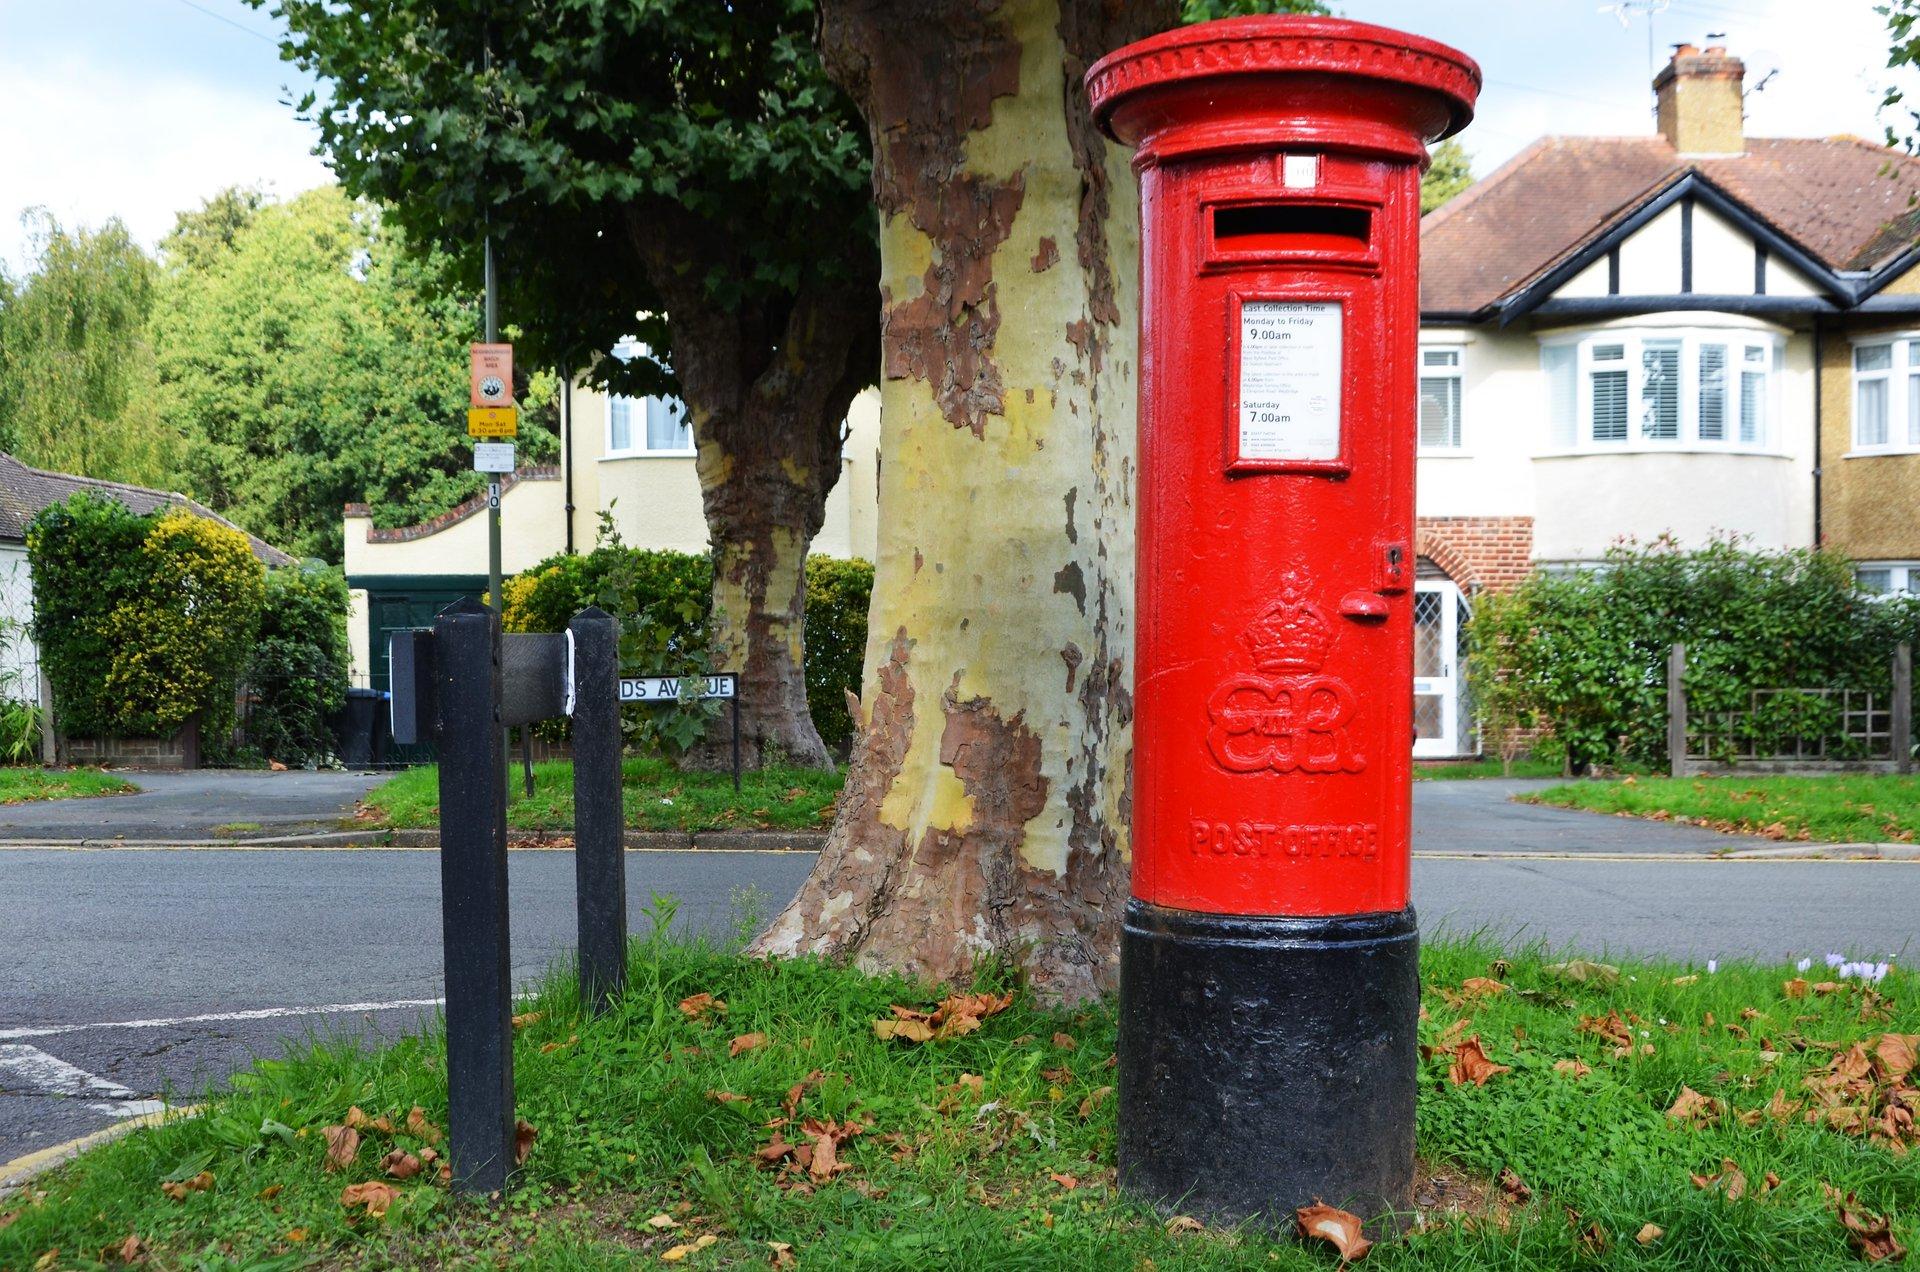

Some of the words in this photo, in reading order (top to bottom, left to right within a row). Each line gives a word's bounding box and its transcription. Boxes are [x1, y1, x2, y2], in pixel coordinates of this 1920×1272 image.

[1243, 304, 1261, 312] Last
[1263, 304, 1303, 312] Collection
[1305, 304, 1326, 312] Time
[1243, 317, 1275, 326] Monday
[1288, 317, 1314, 326] Friday
[1250, 328, 1291, 340] 9.00am
[1243, 401, 1280, 410] Saturday
[1250, 411, 1291, 423] 7.00am
[657, 677, 731, 697] AVUE
[1189, 820, 1277, 857] POST
[1281, 822, 1378, 858] OFFICE
